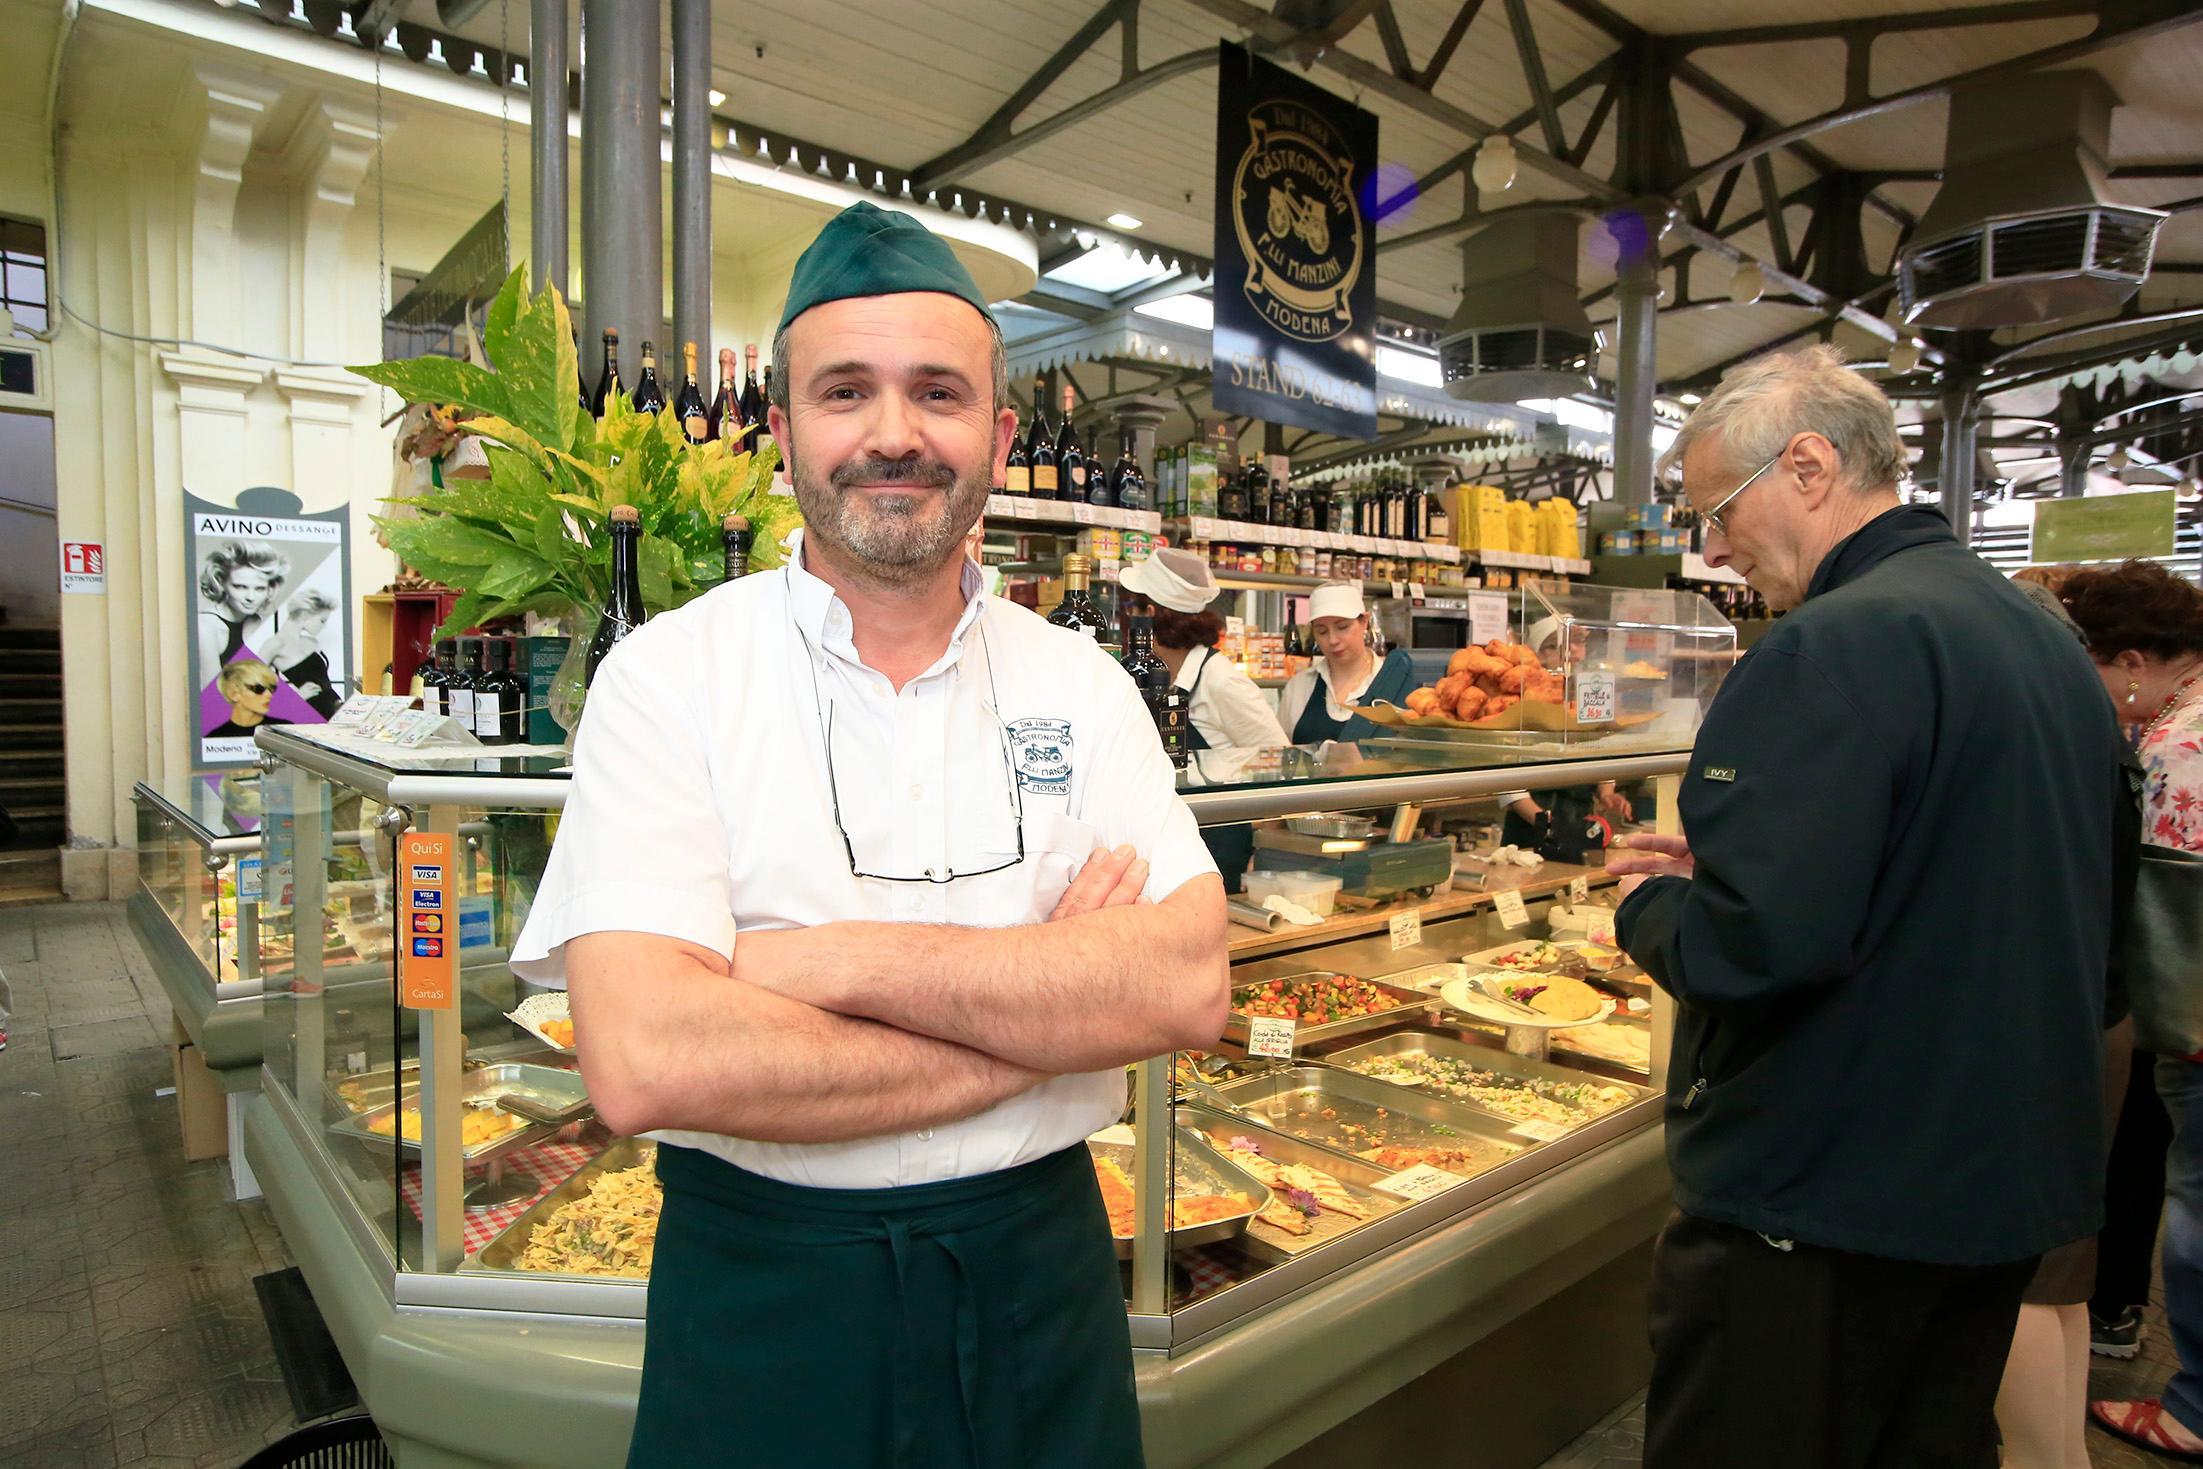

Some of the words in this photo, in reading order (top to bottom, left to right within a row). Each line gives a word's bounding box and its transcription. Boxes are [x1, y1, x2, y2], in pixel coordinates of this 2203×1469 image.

[1253, 150, 1347, 215] GASTRONOMIA
[1287, 256, 1342, 284] MANZINI
[1265, 299, 1331, 334] MODENA
[1231, 351, 1305, 400] STAND
[201, 518, 272, 536] AVINO
[275, 523, 336, 535] DESSANGE
[65, 575, 103, 583] ESTINTORE
[1014, 733, 1070, 746] GASTRONOMIA
[1711, 769, 1729, 777] IVY
[411, 842, 431, 855] Qui
[416, 871, 437, 879] VISA
[415, 900, 440, 908] Electron
[412, 988, 444, 1000] CartaSi
